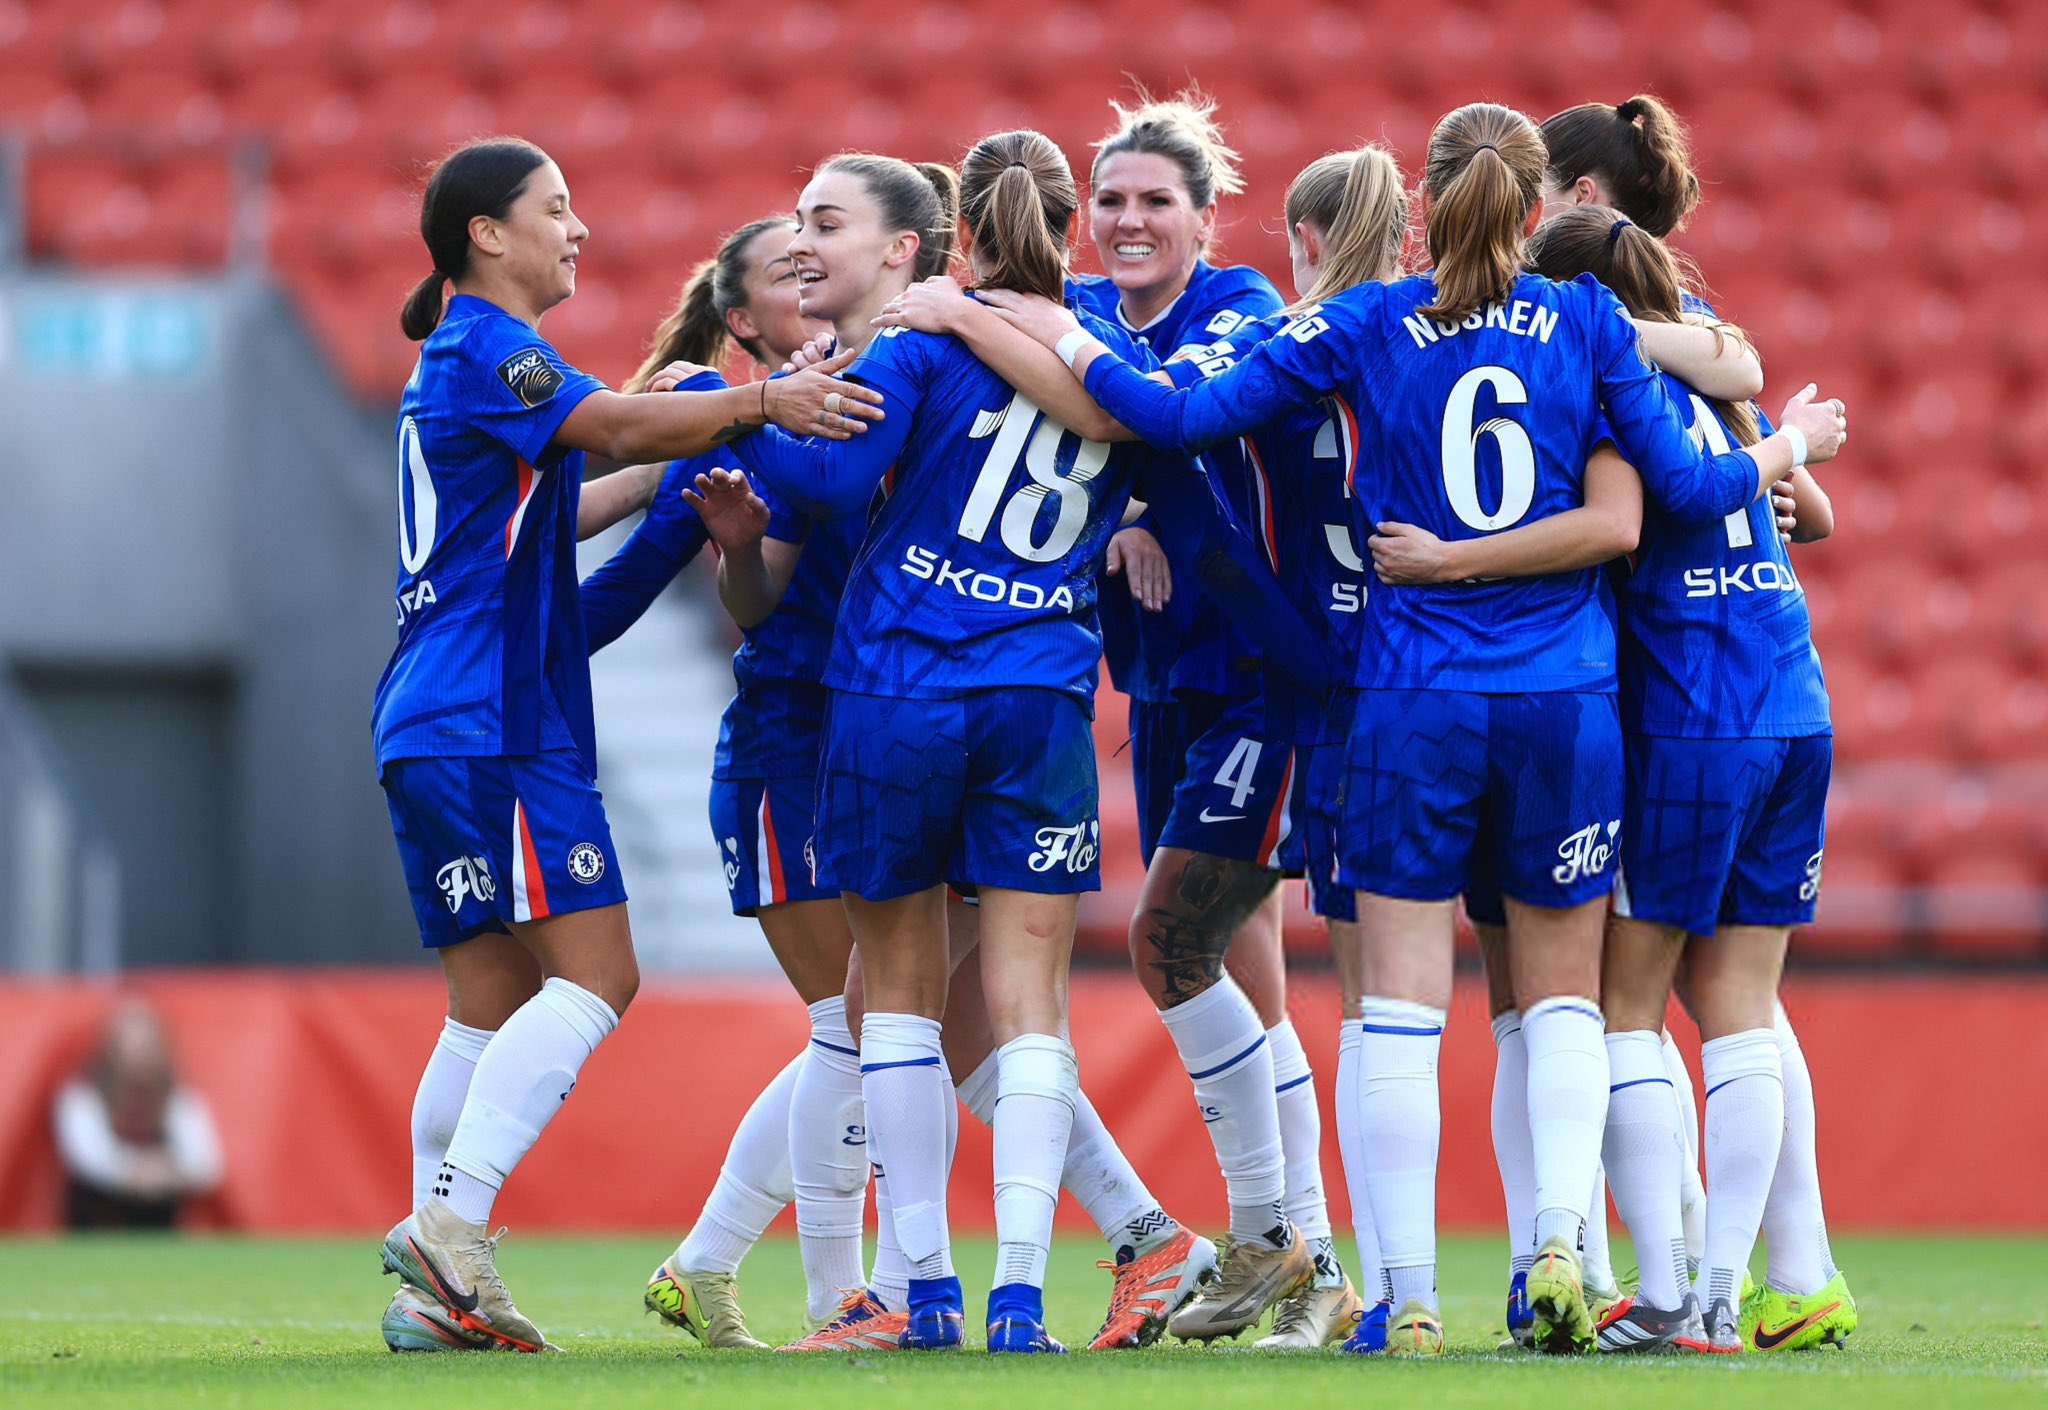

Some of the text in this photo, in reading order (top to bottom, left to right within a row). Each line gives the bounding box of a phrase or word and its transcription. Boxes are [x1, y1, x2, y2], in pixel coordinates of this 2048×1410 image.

[507, 354, 542, 384] WSL
[398, 415, 438, 575] 0
[957, 391, 1111, 562] 18
[1441, 365, 1536, 532] 6
[1684, 561, 1804, 598] SKOD
[1213, 737, 1263, 809] 4
